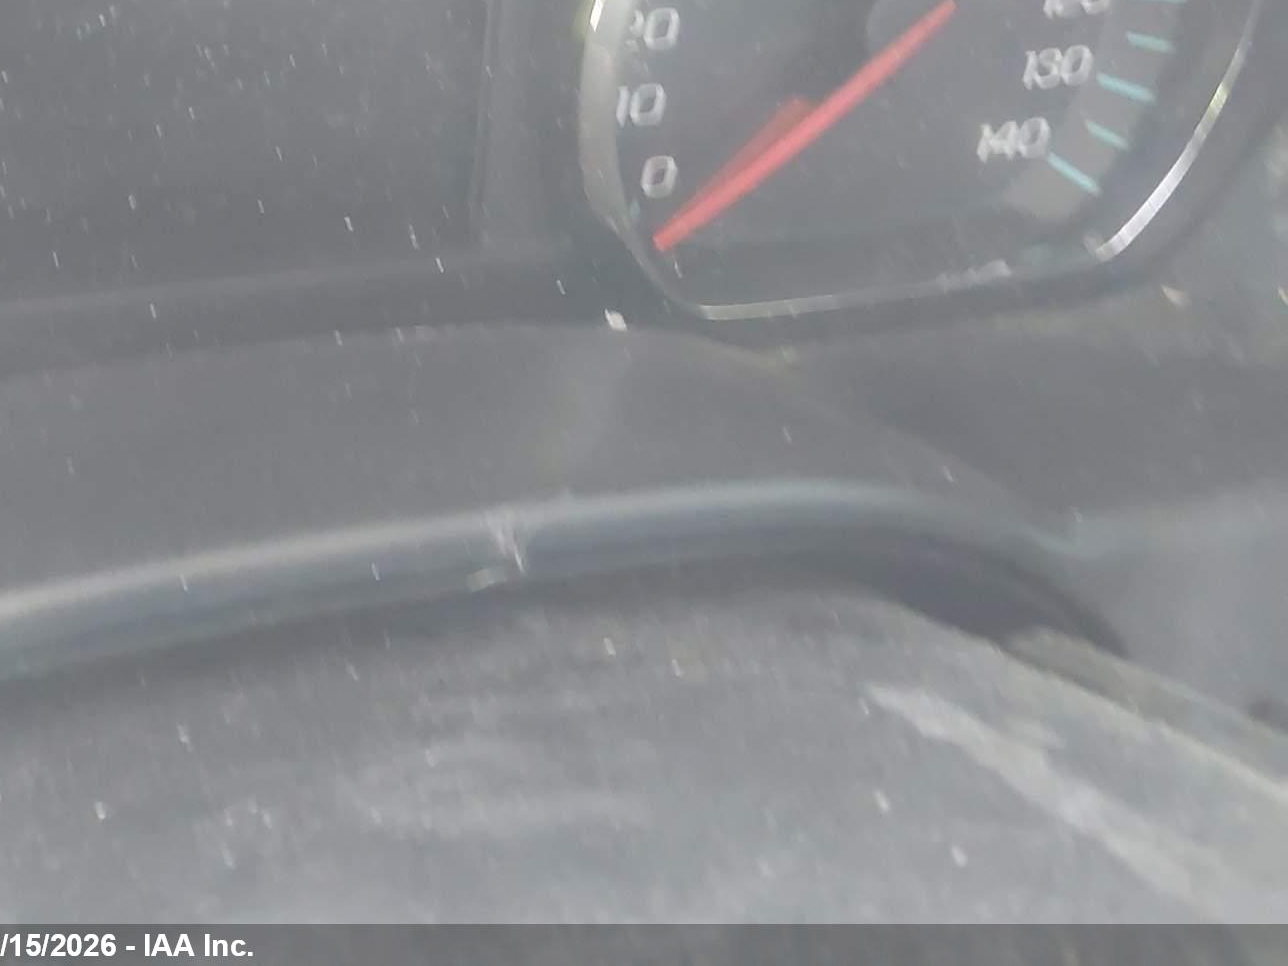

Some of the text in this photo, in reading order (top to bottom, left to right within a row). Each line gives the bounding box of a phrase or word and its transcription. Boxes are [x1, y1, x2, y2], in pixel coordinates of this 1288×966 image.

[1022, 44, 1094, 91] 130
[616, 83, 666, 128] 10
[976, 116, 1052, 164] 140
[641, 155, 678, 199] 0
